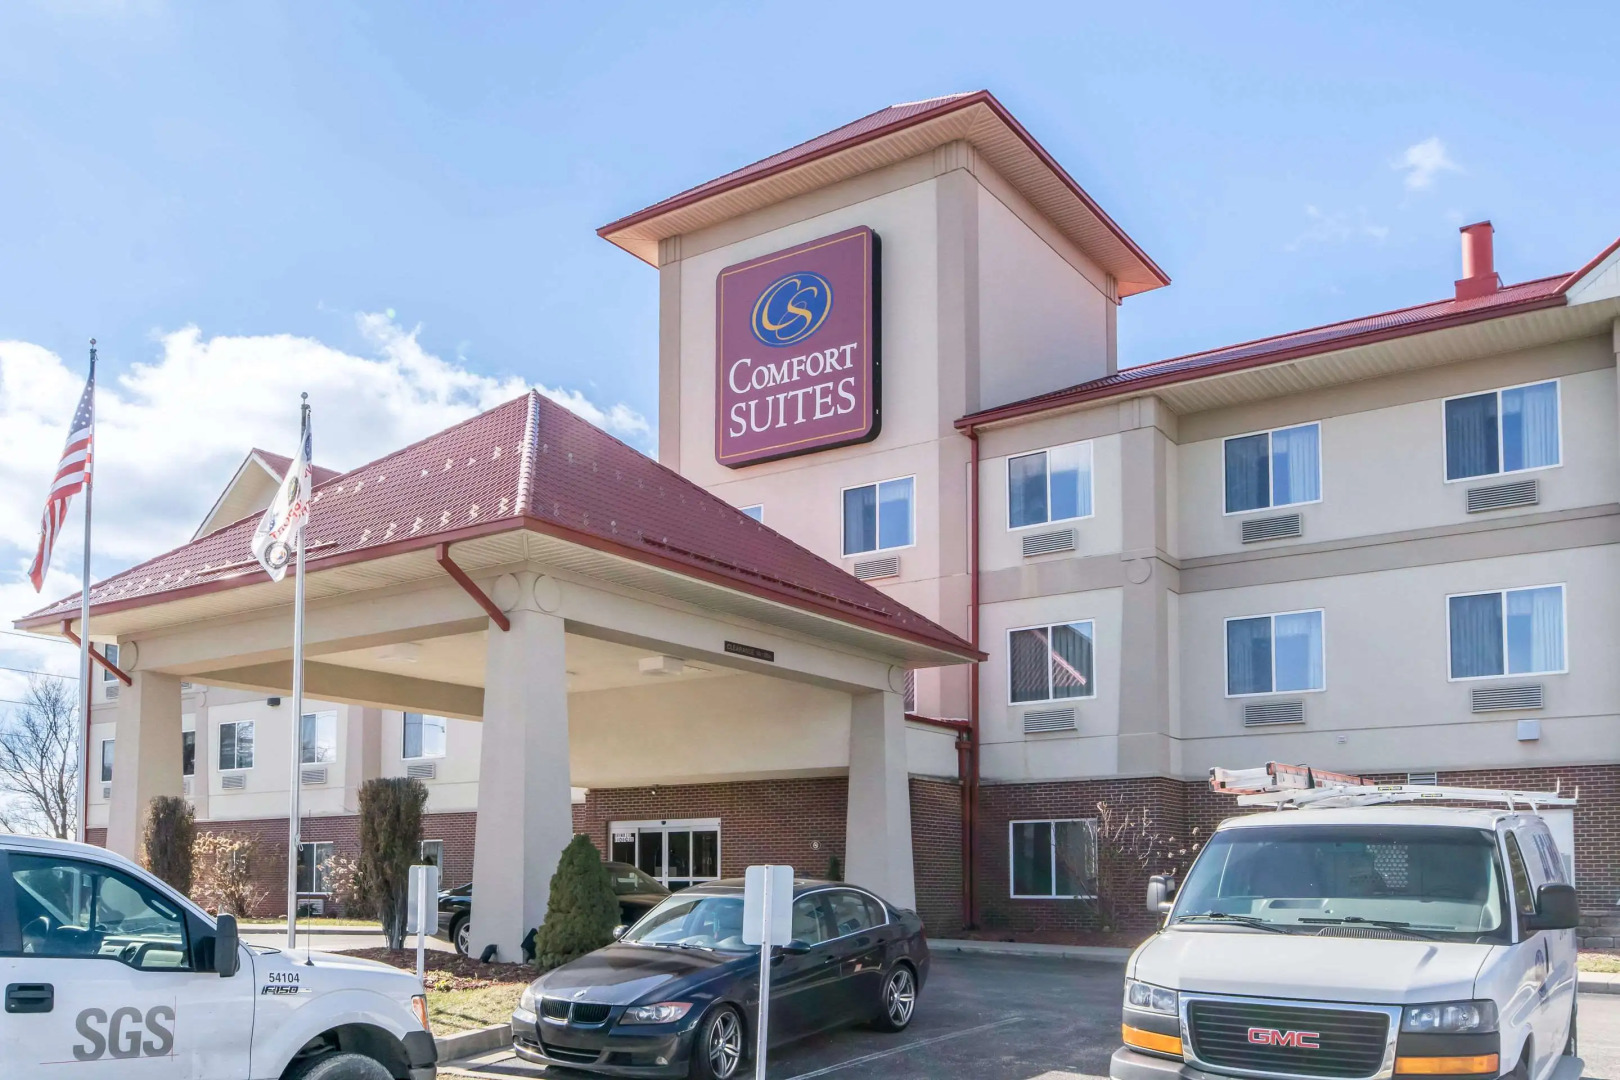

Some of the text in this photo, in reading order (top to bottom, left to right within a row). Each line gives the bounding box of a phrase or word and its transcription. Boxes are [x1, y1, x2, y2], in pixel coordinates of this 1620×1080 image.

[728, 342, 858, 394] COMFORT
[729, 377, 857, 438] SUITES
[268, 972, 300, 983] 54104
[72, 1005, 176, 1062] SGS
[1247, 1027, 1320, 1049] GMC
